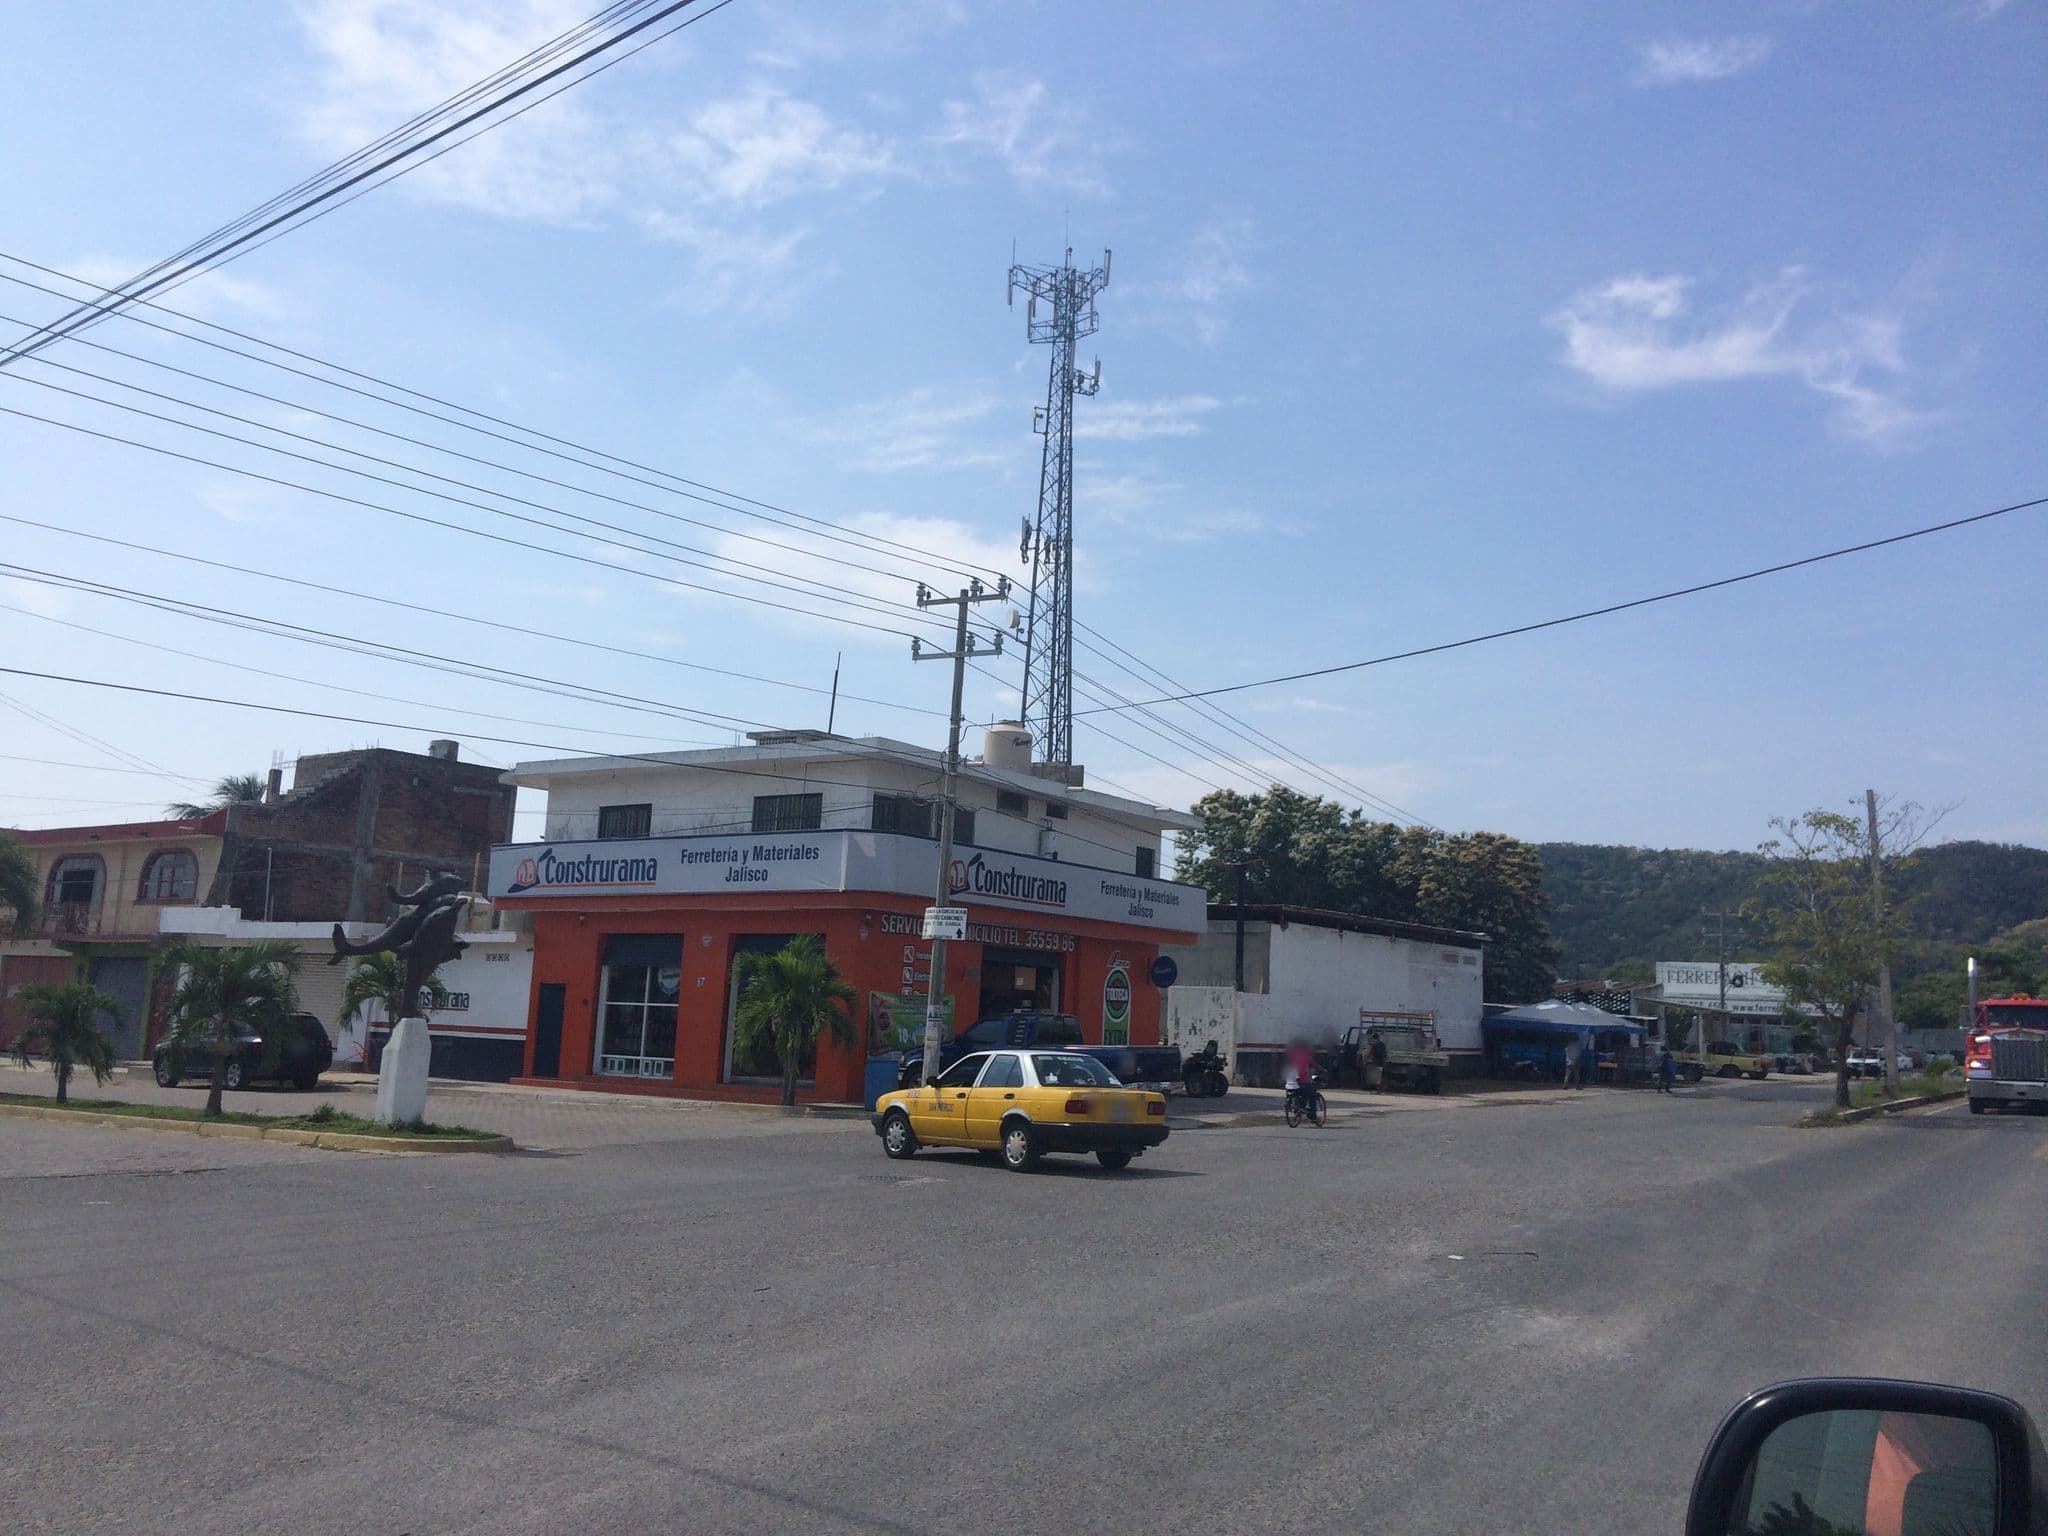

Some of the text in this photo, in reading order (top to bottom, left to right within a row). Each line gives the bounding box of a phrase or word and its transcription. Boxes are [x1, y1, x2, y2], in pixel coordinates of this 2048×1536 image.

[680, 844, 819, 865] Ferretería y Materiales
[545, 854, 658, 884] Construrama
[725, 866, 769, 883] Jalisco
[975, 861, 1067, 903] Construrama
[1144, 888, 1180, 906] Materiales
[1128, 903, 1154, 918] Jalisco
[1061, 935, 1075, 952] 86
